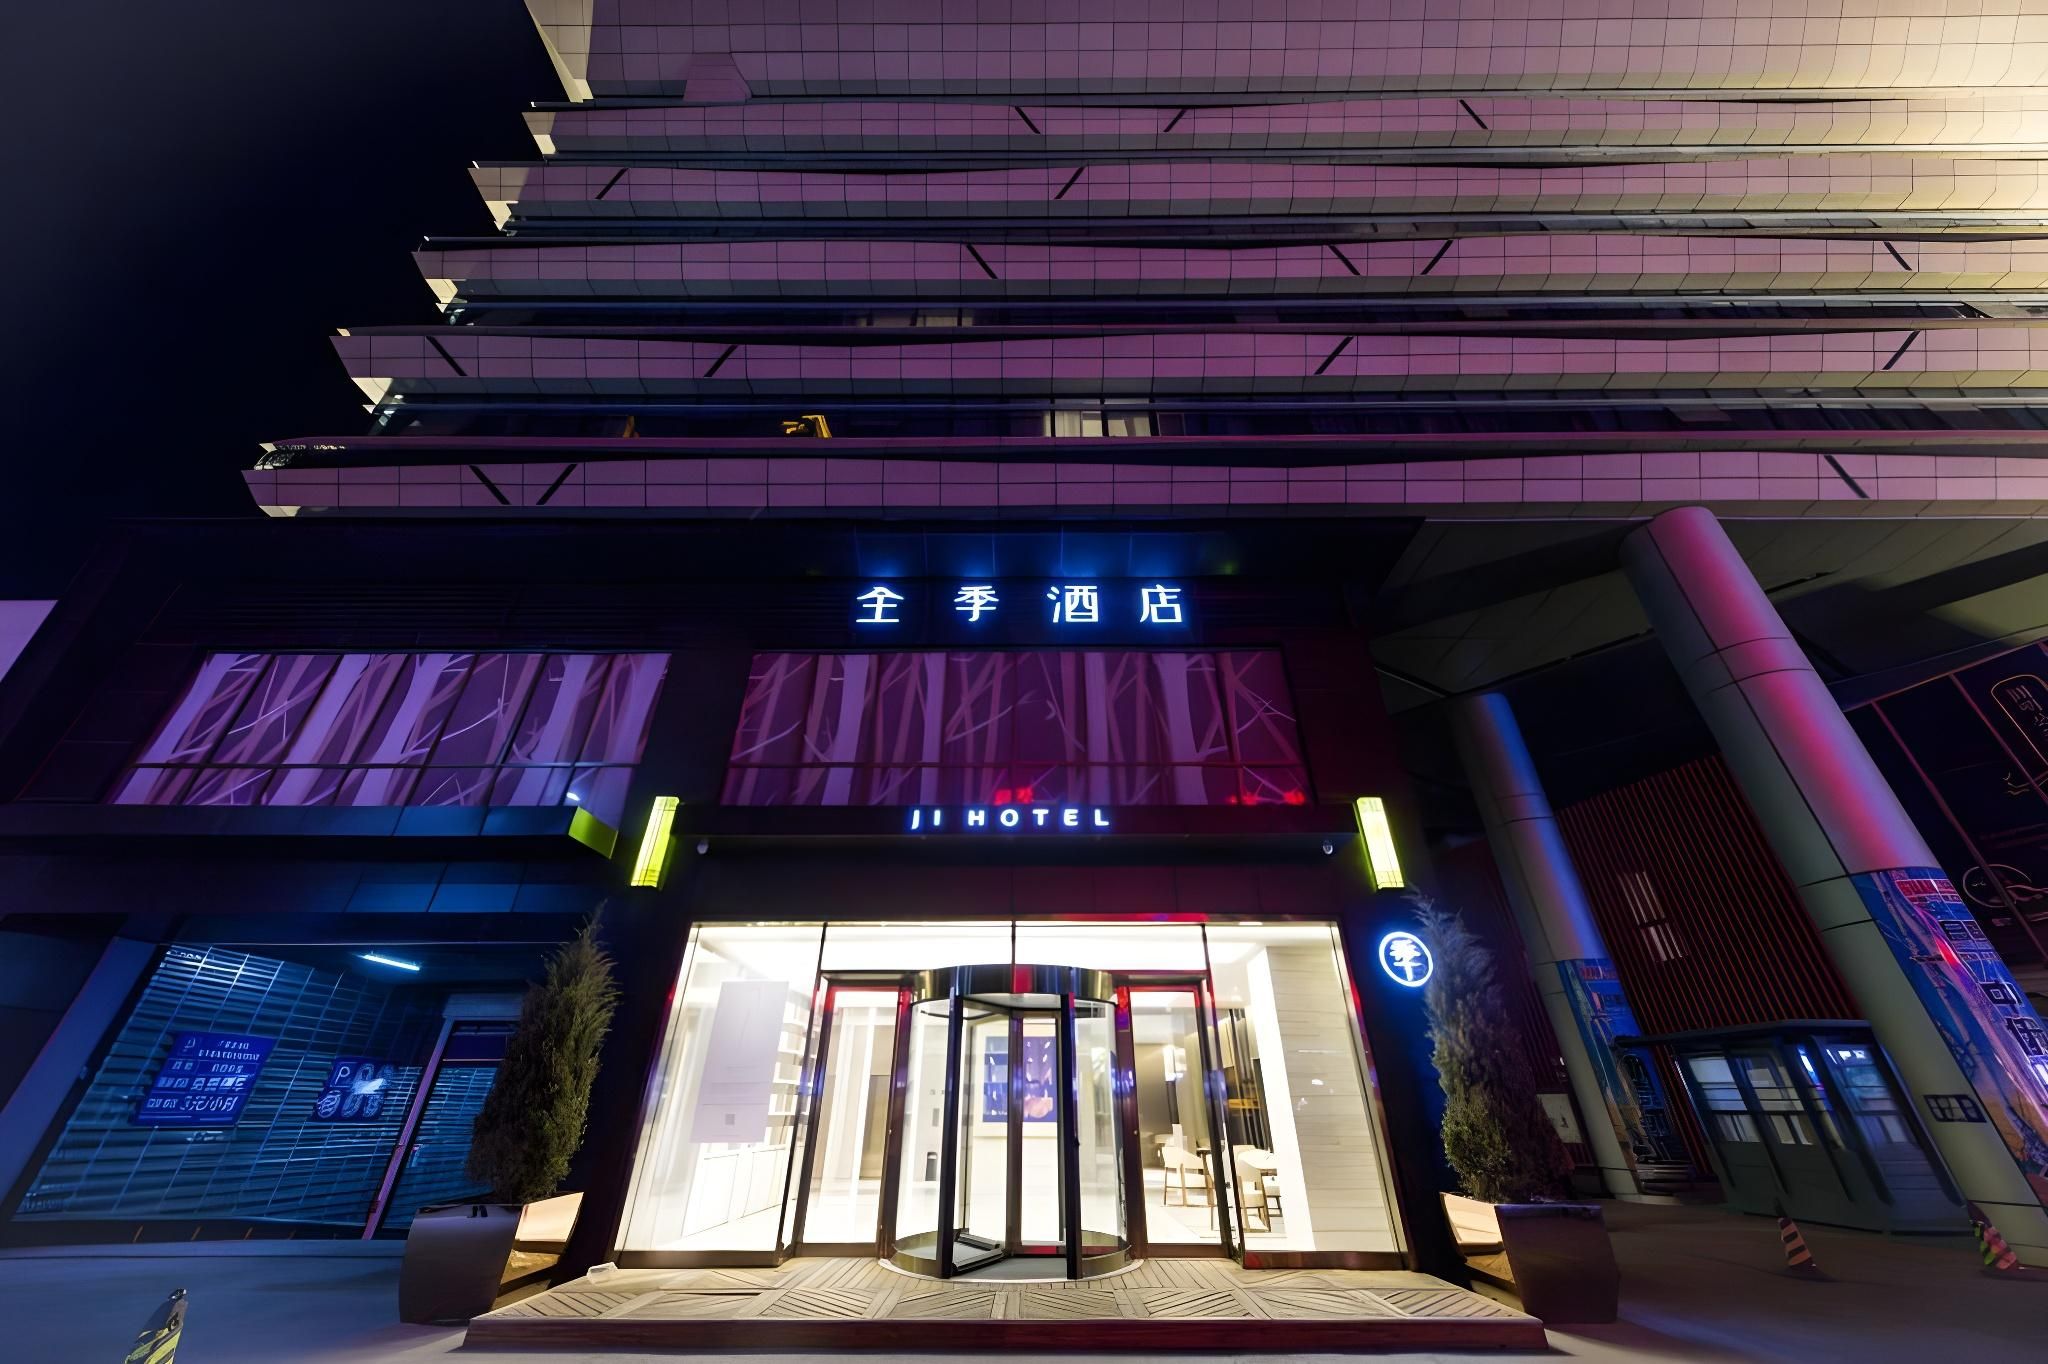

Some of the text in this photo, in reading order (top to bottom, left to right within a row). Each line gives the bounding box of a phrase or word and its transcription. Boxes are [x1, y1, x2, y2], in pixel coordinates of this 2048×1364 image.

[855, 584, 1184, 624] 全季酒店
[911, 808, 1111, 830] JI HOTEL
